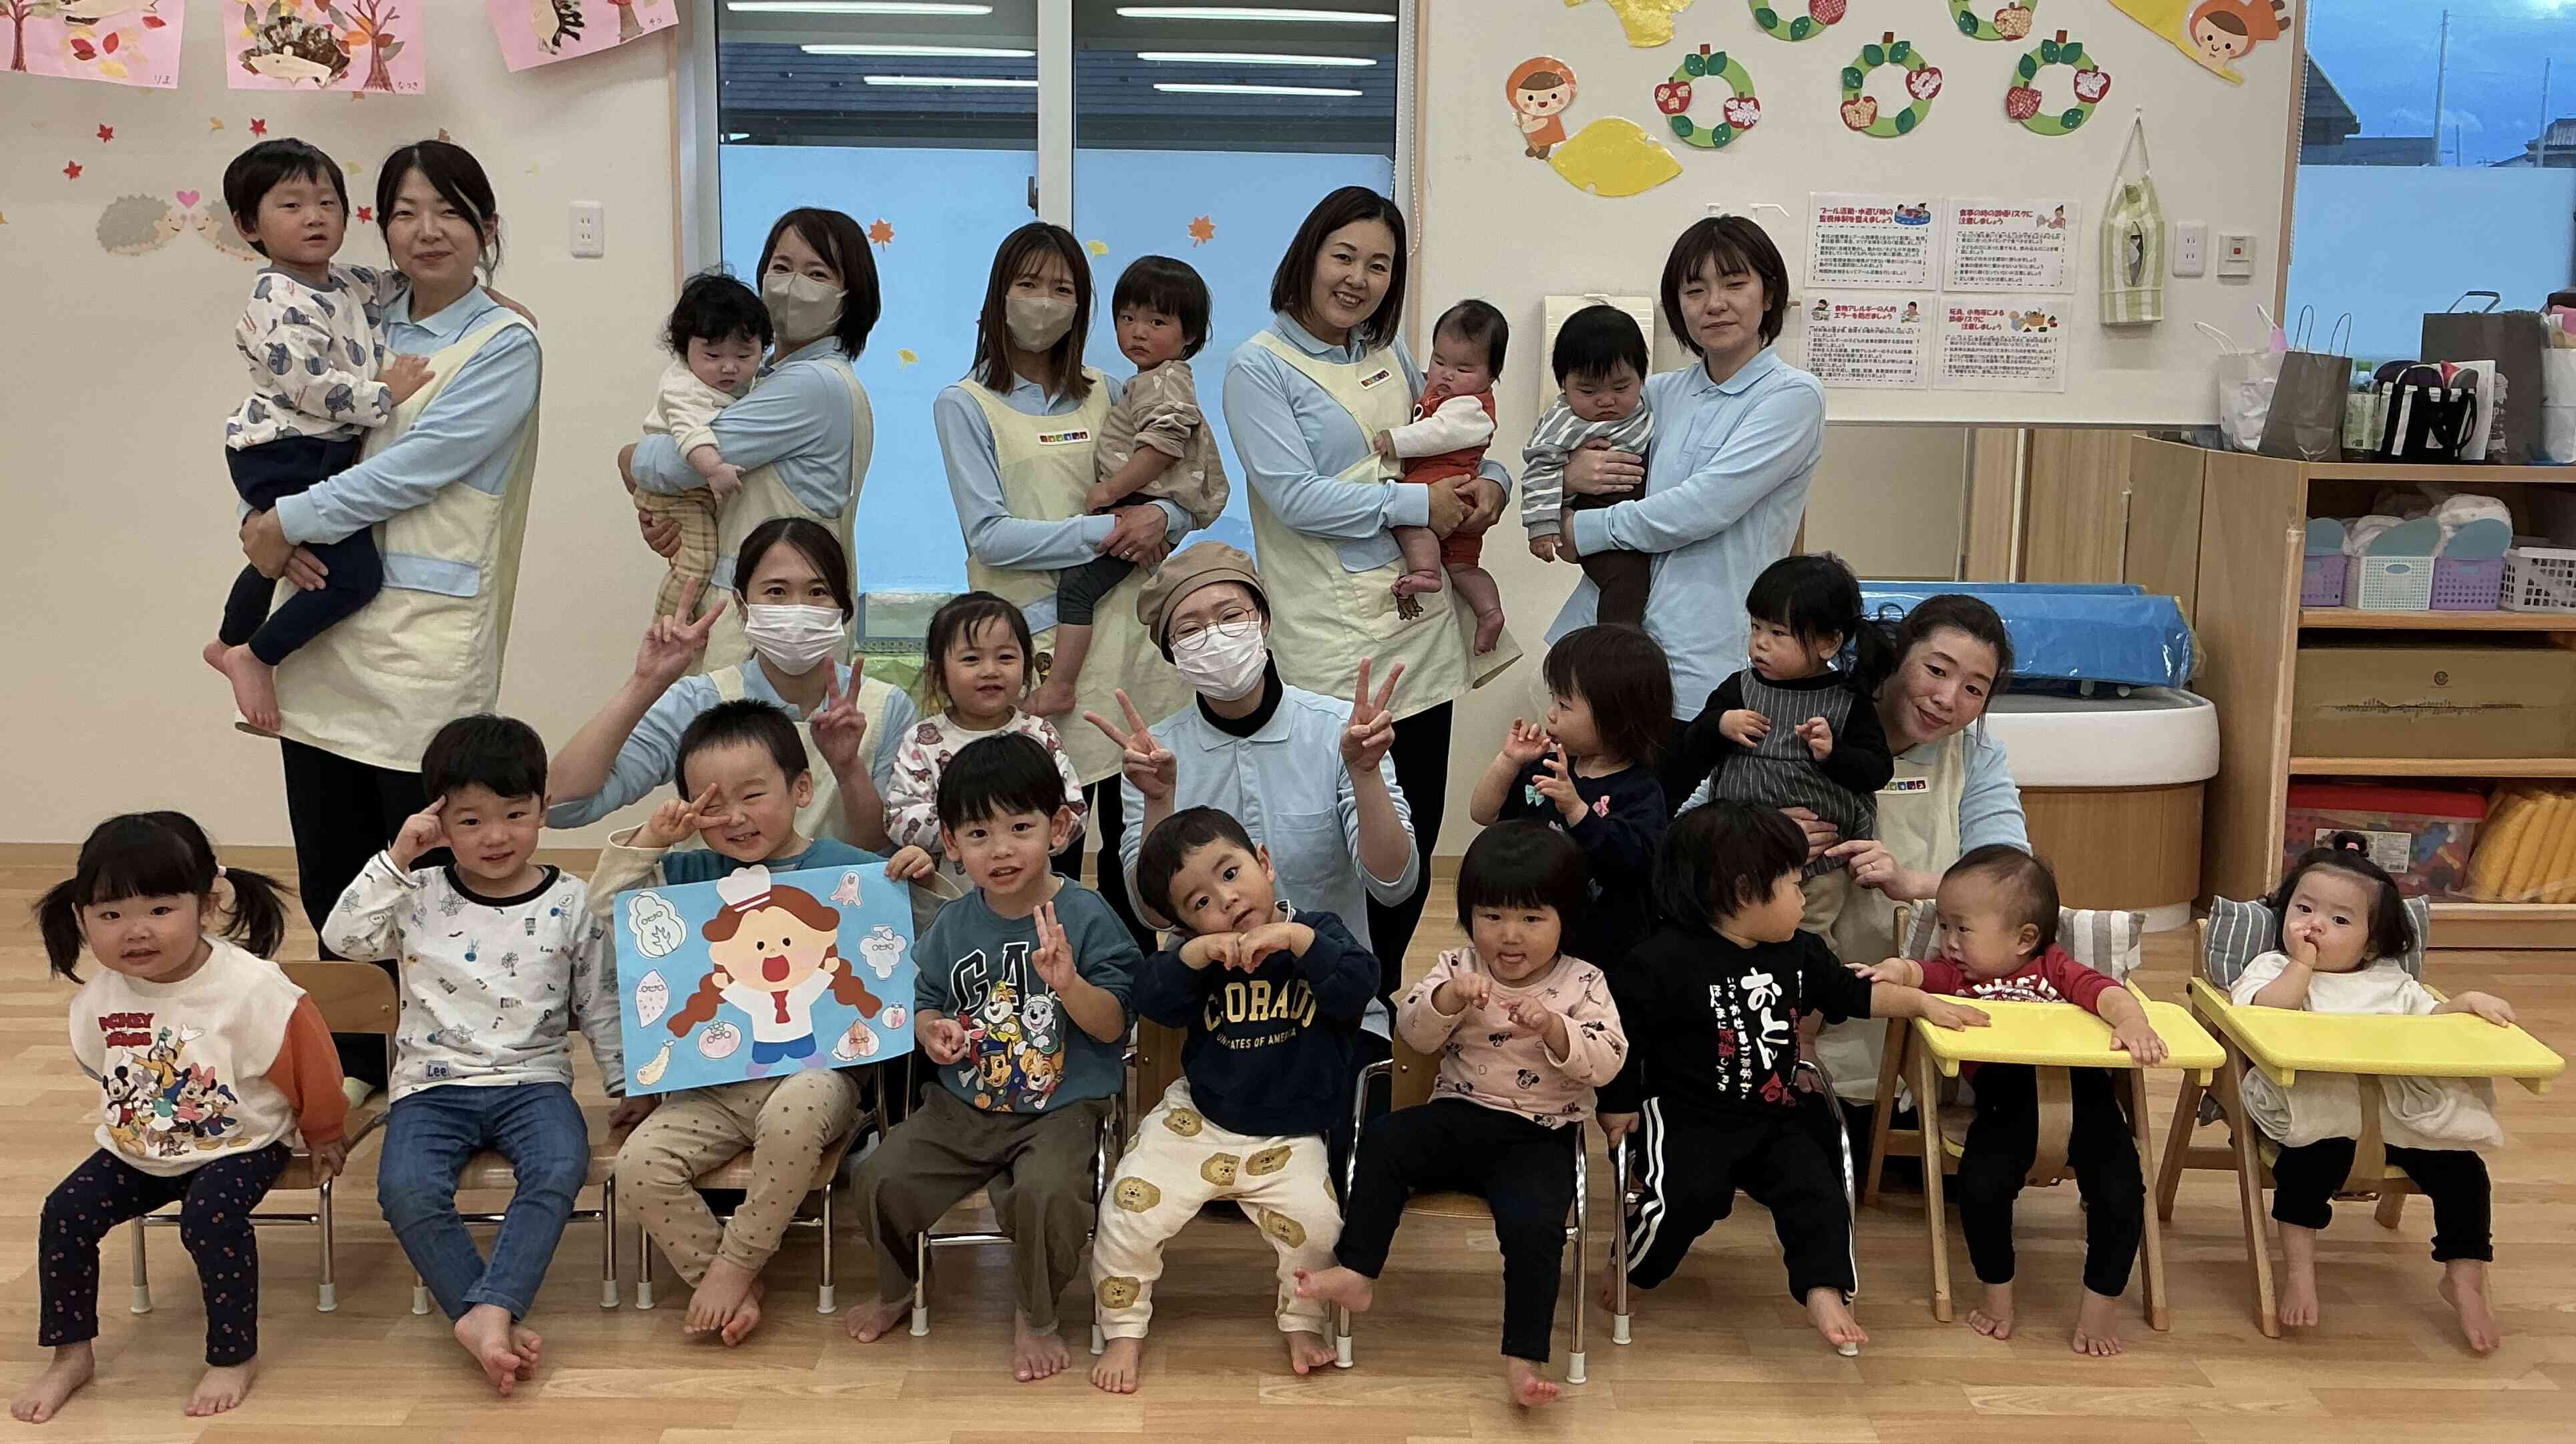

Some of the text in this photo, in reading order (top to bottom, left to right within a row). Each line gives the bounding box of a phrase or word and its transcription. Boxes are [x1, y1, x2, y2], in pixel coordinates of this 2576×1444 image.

[1958, 217, 2004, 225] 注意しましょう
[1833, 312, 1893, 320] エラーを防ぎましょう
[951, 941, 1061, 1018] GA
[1254, 1037, 1266, 1047] OF
[427, 1065, 447, 1077] Lee
